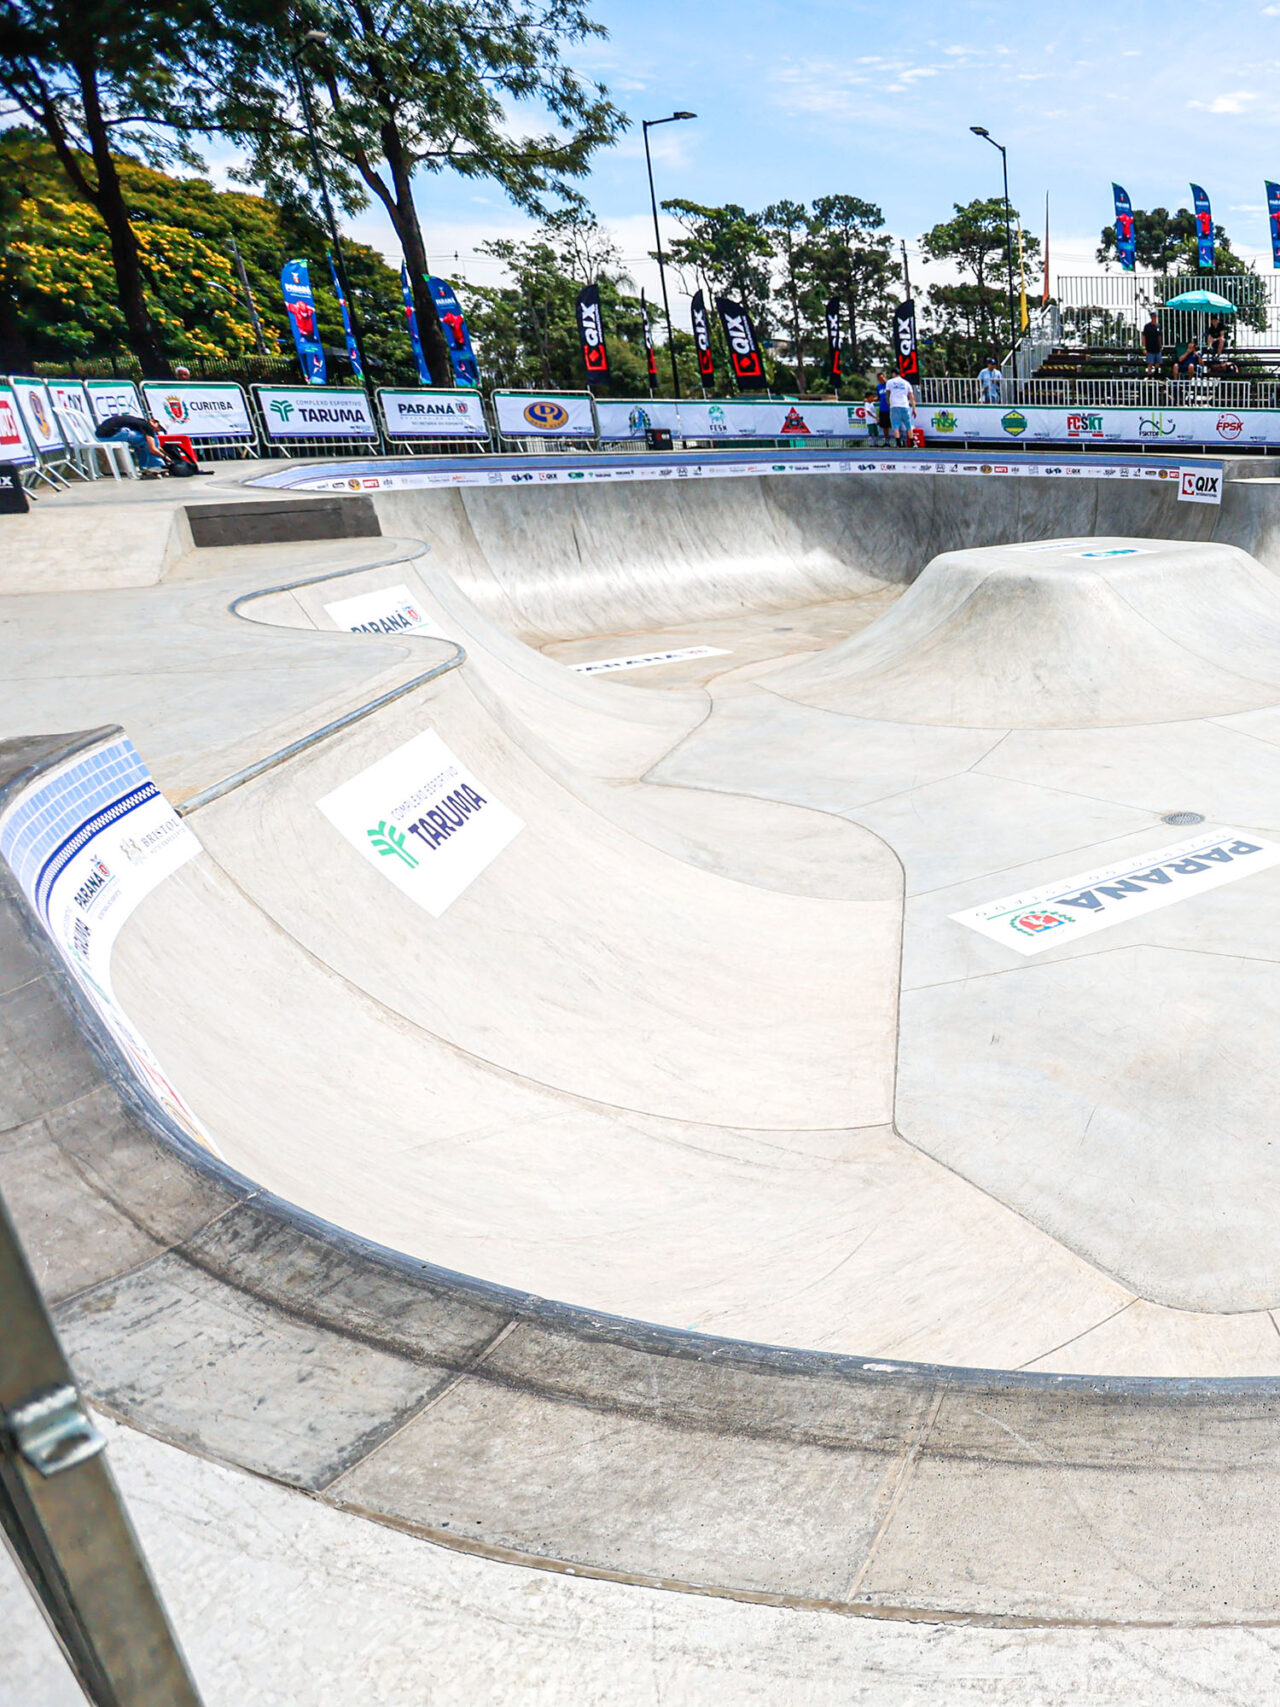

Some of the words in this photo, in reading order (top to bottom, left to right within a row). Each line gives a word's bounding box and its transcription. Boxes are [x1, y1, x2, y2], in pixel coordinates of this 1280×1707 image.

[580, 302, 599, 346] QIX
[693, 309, 707, 351] QIX
[724, 313, 751, 354] QIX
[897, 317, 912, 356] QIX
[190, 401, 233, 412] CURITIBA
[397, 402, 455, 415] PARANÁ
[298, 408, 366, 423] TARUMA
[931, 417, 958, 428] FNSK
[1067, 416, 1103, 430] FCSKT
[1216, 422, 1244, 431] FPSK
[1195, 476, 1219, 493] QIX
[407, 783, 488, 851] TARUMA
[1054, 840, 1264, 914] PARANÁ
